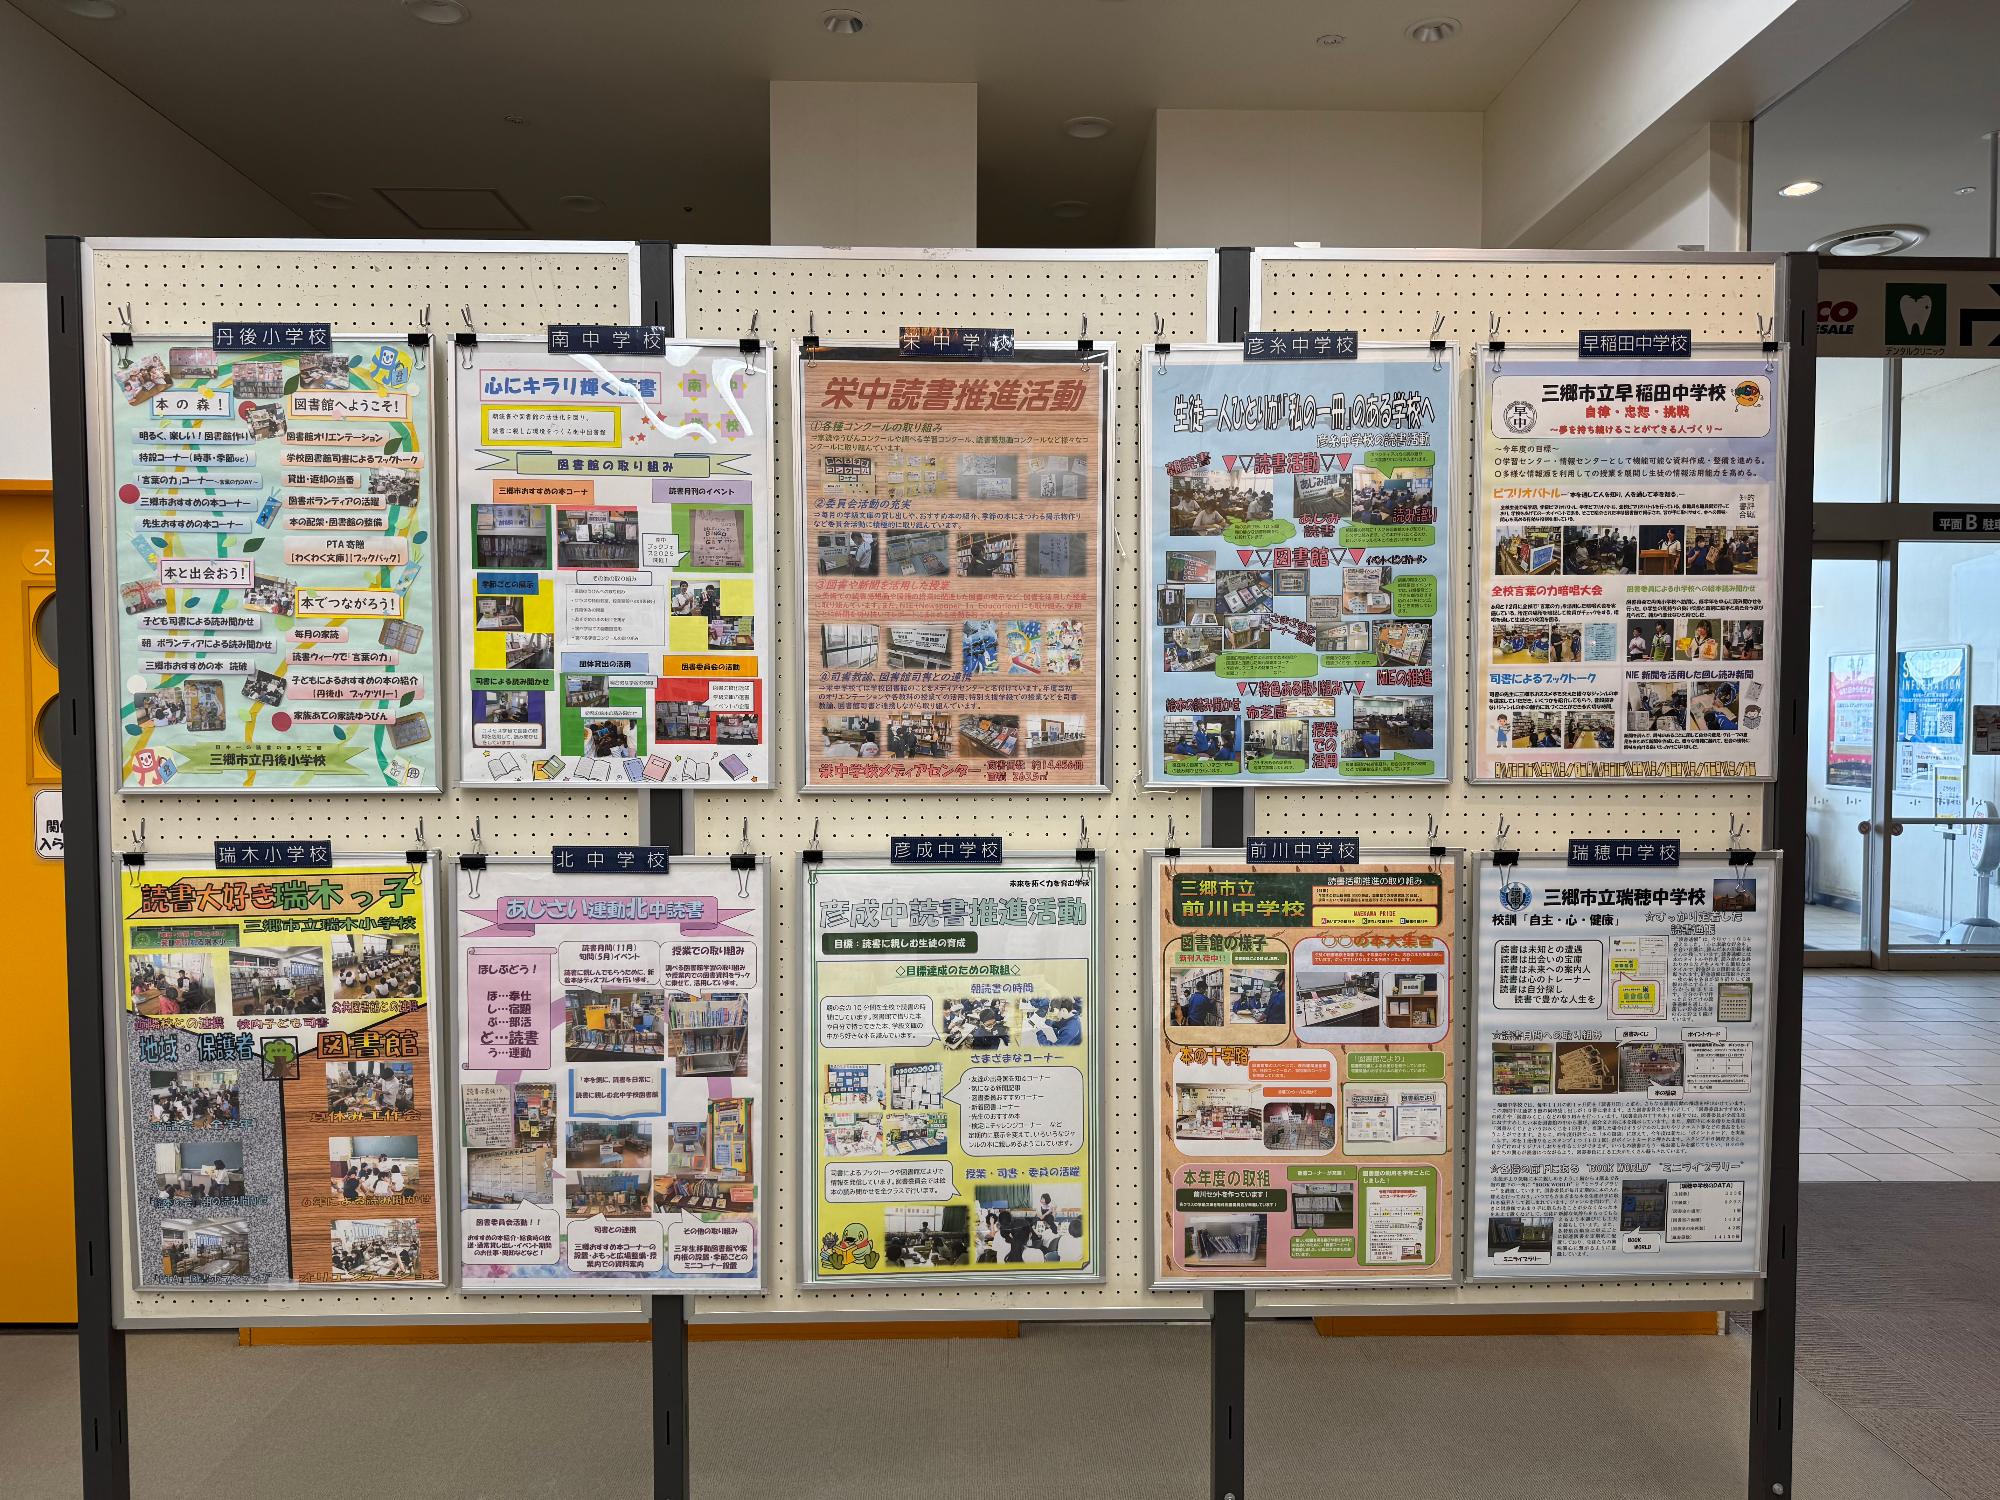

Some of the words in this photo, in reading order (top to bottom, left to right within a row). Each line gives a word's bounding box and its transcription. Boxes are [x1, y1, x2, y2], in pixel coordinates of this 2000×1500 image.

[216, 327, 327, 346] 丹後小学校
[552, 330, 661, 350] 南中学校
[903, 332, 1010, 352] 栄中学校
[1582, 334, 1687, 352] 早稲田中学校
[1247, 337, 1354, 355] 彦糸中学校
[1885, 347, 1944, 355] デンタルクリニック
[821, 376, 1087, 412] 栄中読書推進活動
[1541, 383, 1727, 403] 三郷市立早稲田中学校
[155, 397, 223, 411] 本の森！
[294, 398, 399, 413] 図書館へようこそ！
[1173, 391, 1436, 433] 生徒一人ひとりが「私の一冊」のある学校へ
[1585, 405, 1690, 419] 自律・忠恕・挑戦
[810, 421, 943, 433] ①各種コンクールの取り組み
[287, 431, 383, 444] 図書館オリエンテーション
[1316, 433, 1431, 449] 彦糸中学校の読書活動
[286, 453, 418, 465] 学校図書館司書によるブックトーク
[1253, 452, 1320, 474] 読書活動
[558, 459, 674, 473] 図書館の取り組み
[288, 474, 355, 485] 貸出・返却の当番
[498, 486, 589, 497] 三郷市おすすめの本コーナ
[1493, 487, 1561, 499] ビブリオバトル
[140, 496, 251, 508] 三郷市おすすめの本コーナー
[288, 496, 380, 507] 図書ボランティアの活躍
[814, 498, 912, 510] ②委員会活動の充実
[142, 518, 243, 529] 先生おすすめの本コーナー
[289, 516, 383, 528] 本の配架・図書館の整備
[1299, 513, 1341, 525] あじみ
[1939, 518, 1962, 530] 平面
[1966, 514, 1977, 530] B
[1303, 525, 1336, 538] 読書
[326, 539, 344, 549] PTA
[346, 539, 365, 549] 寄贈
[1273, 547, 1329, 568] 図書館
[164, 567, 245, 580] 本と出会おう！
[482, 580, 534, 589] 季節ごとの展示
[816, 580, 950, 591] ③図書や新聞を活用した授業
[1491, 584, 1603, 597] 全校言葉の力暗唱大会
[300, 596, 395, 610] 本でつながろう！
[143, 615, 254, 626] 子ども司書による読み聞かせ
[294, 629, 339, 640] 毎月の家読
[141, 638, 152, 649] 朝
[157, 638, 272, 649] ボランティアによる読み聞かせ
[145, 661, 223, 671] 三郷市おすすめの本
[229, 661, 248, 672] 読破
[579, 660, 632, 669] 団体貸出の活用
[681, 662, 741, 671] 図書委員会の活動
[291, 675, 418, 686] 子どもによるおすすめの本の紹介
[1376, 668, 1433, 687] NIEの推進
[1489, 673, 1597, 685] 司書によるブックトーク
[1626, 670, 1640, 679] NIE
[1641, 669, 1754, 680] 新聞を活用した回し読み新聞
[474, 677, 550, 686] 司書による読み聞かせ
[1258, 681, 1343, 697] 特色ある取り組み
[1165, 698, 1242, 712] 絵本の読み聞かせ
[293, 710, 388, 721] 家族あての家読ゆうびん
[1246, 705, 1288, 719] 布芝居
[1312, 721, 1338, 737] 授業
[1312, 737, 1338, 752] での
[210, 753, 327, 767] 三郷市立丹後小学校
[1312, 753, 1338, 769] 活用
[818, 763, 981, 779] 栄中学校メディアセンター
[46, 819, 64, 833] 関
[219, 846, 328, 865] 瑞木小学校
[894, 842, 999, 859] 彦成中学校
[1250, 842, 1356, 859] 前川中学校
[1572, 844, 1677, 862] 瑞穂中学校
[556, 851, 665, 869] 北中学校
[1009, 879, 1090, 888] 未来を拓く力を育む学校
[1327, 876, 1423, 886] 読書活動推進の取り組み
[1179, 879, 1256, 897] 三郷市立
[141, 878, 415, 913] 読書大好き瑞木っ子
[1544, 888, 1706, 906] 三郷市立瑞穂中学校
[505, 898, 705, 920] あじさい運動北中読書
[819, 897, 1087, 929] 彦成中読書推進活動
[1182, 900, 1306, 917] 前川中学校
[243, 915, 417, 934] 三郷市立瑞木小学校
[1492, 913, 1620, 927] 校訓「自主・心・健康」
[834, 937, 967, 950] 目標：読書に親しむ生徒の育成
[1180, 933, 1269, 952] 図書館の様子
[1500, 944, 1583, 954] 読書は未知との遭遇
[672, 945, 745, 956] 授業での取り組み
[1500, 954, 1583, 964] 読書は出会いの宝庫
[478, 963, 538, 975] ほしぶどう！
[1500, 964, 1591, 974] 読書は未来への案内人
[1500, 974, 1591, 984] 読書は心のトレーナー
[970, 982, 1034, 994] 朝読書の時間
[1500, 984, 1563, 994] 読書は自分探し
[487, 990, 532, 1002] ほ…奉仕
[1514, 994, 1596, 1004] 読書で豊かな人生を
[487, 1003, 532, 1015] し…宿題
[487, 1016, 532, 1028] ぶ…部活
[480, 1030, 539, 1045] ど…読書
[139, 1032, 255, 1063] 地域・保護者
[316, 1029, 419, 1060] 図書館
[487, 1047, 532, 1059] う…運動
[971, 1053, 1065, 1064] さまざまなコーナー
[1179, 1046, 1250, 1066] 本の十字路
[575, 1091, 659, 1099] 読書に親しむ北中学校図書館
[965, 1166, 1080, 1179] 授業・司書・委員の活躍
[1183, 1168, 1271, 1188] 本年度の取組
[594, 1226, 637, 1234] 司書との連携
[683, 1227, 738, 1235] その他の取り組み
[574, 1243, 657, 1251] 三郷おすすめ本コーナーの
[586, 1260, 645, 1268] 業内での資料案内
[683, 1262, 738, 1270] ミニコーナー設置
